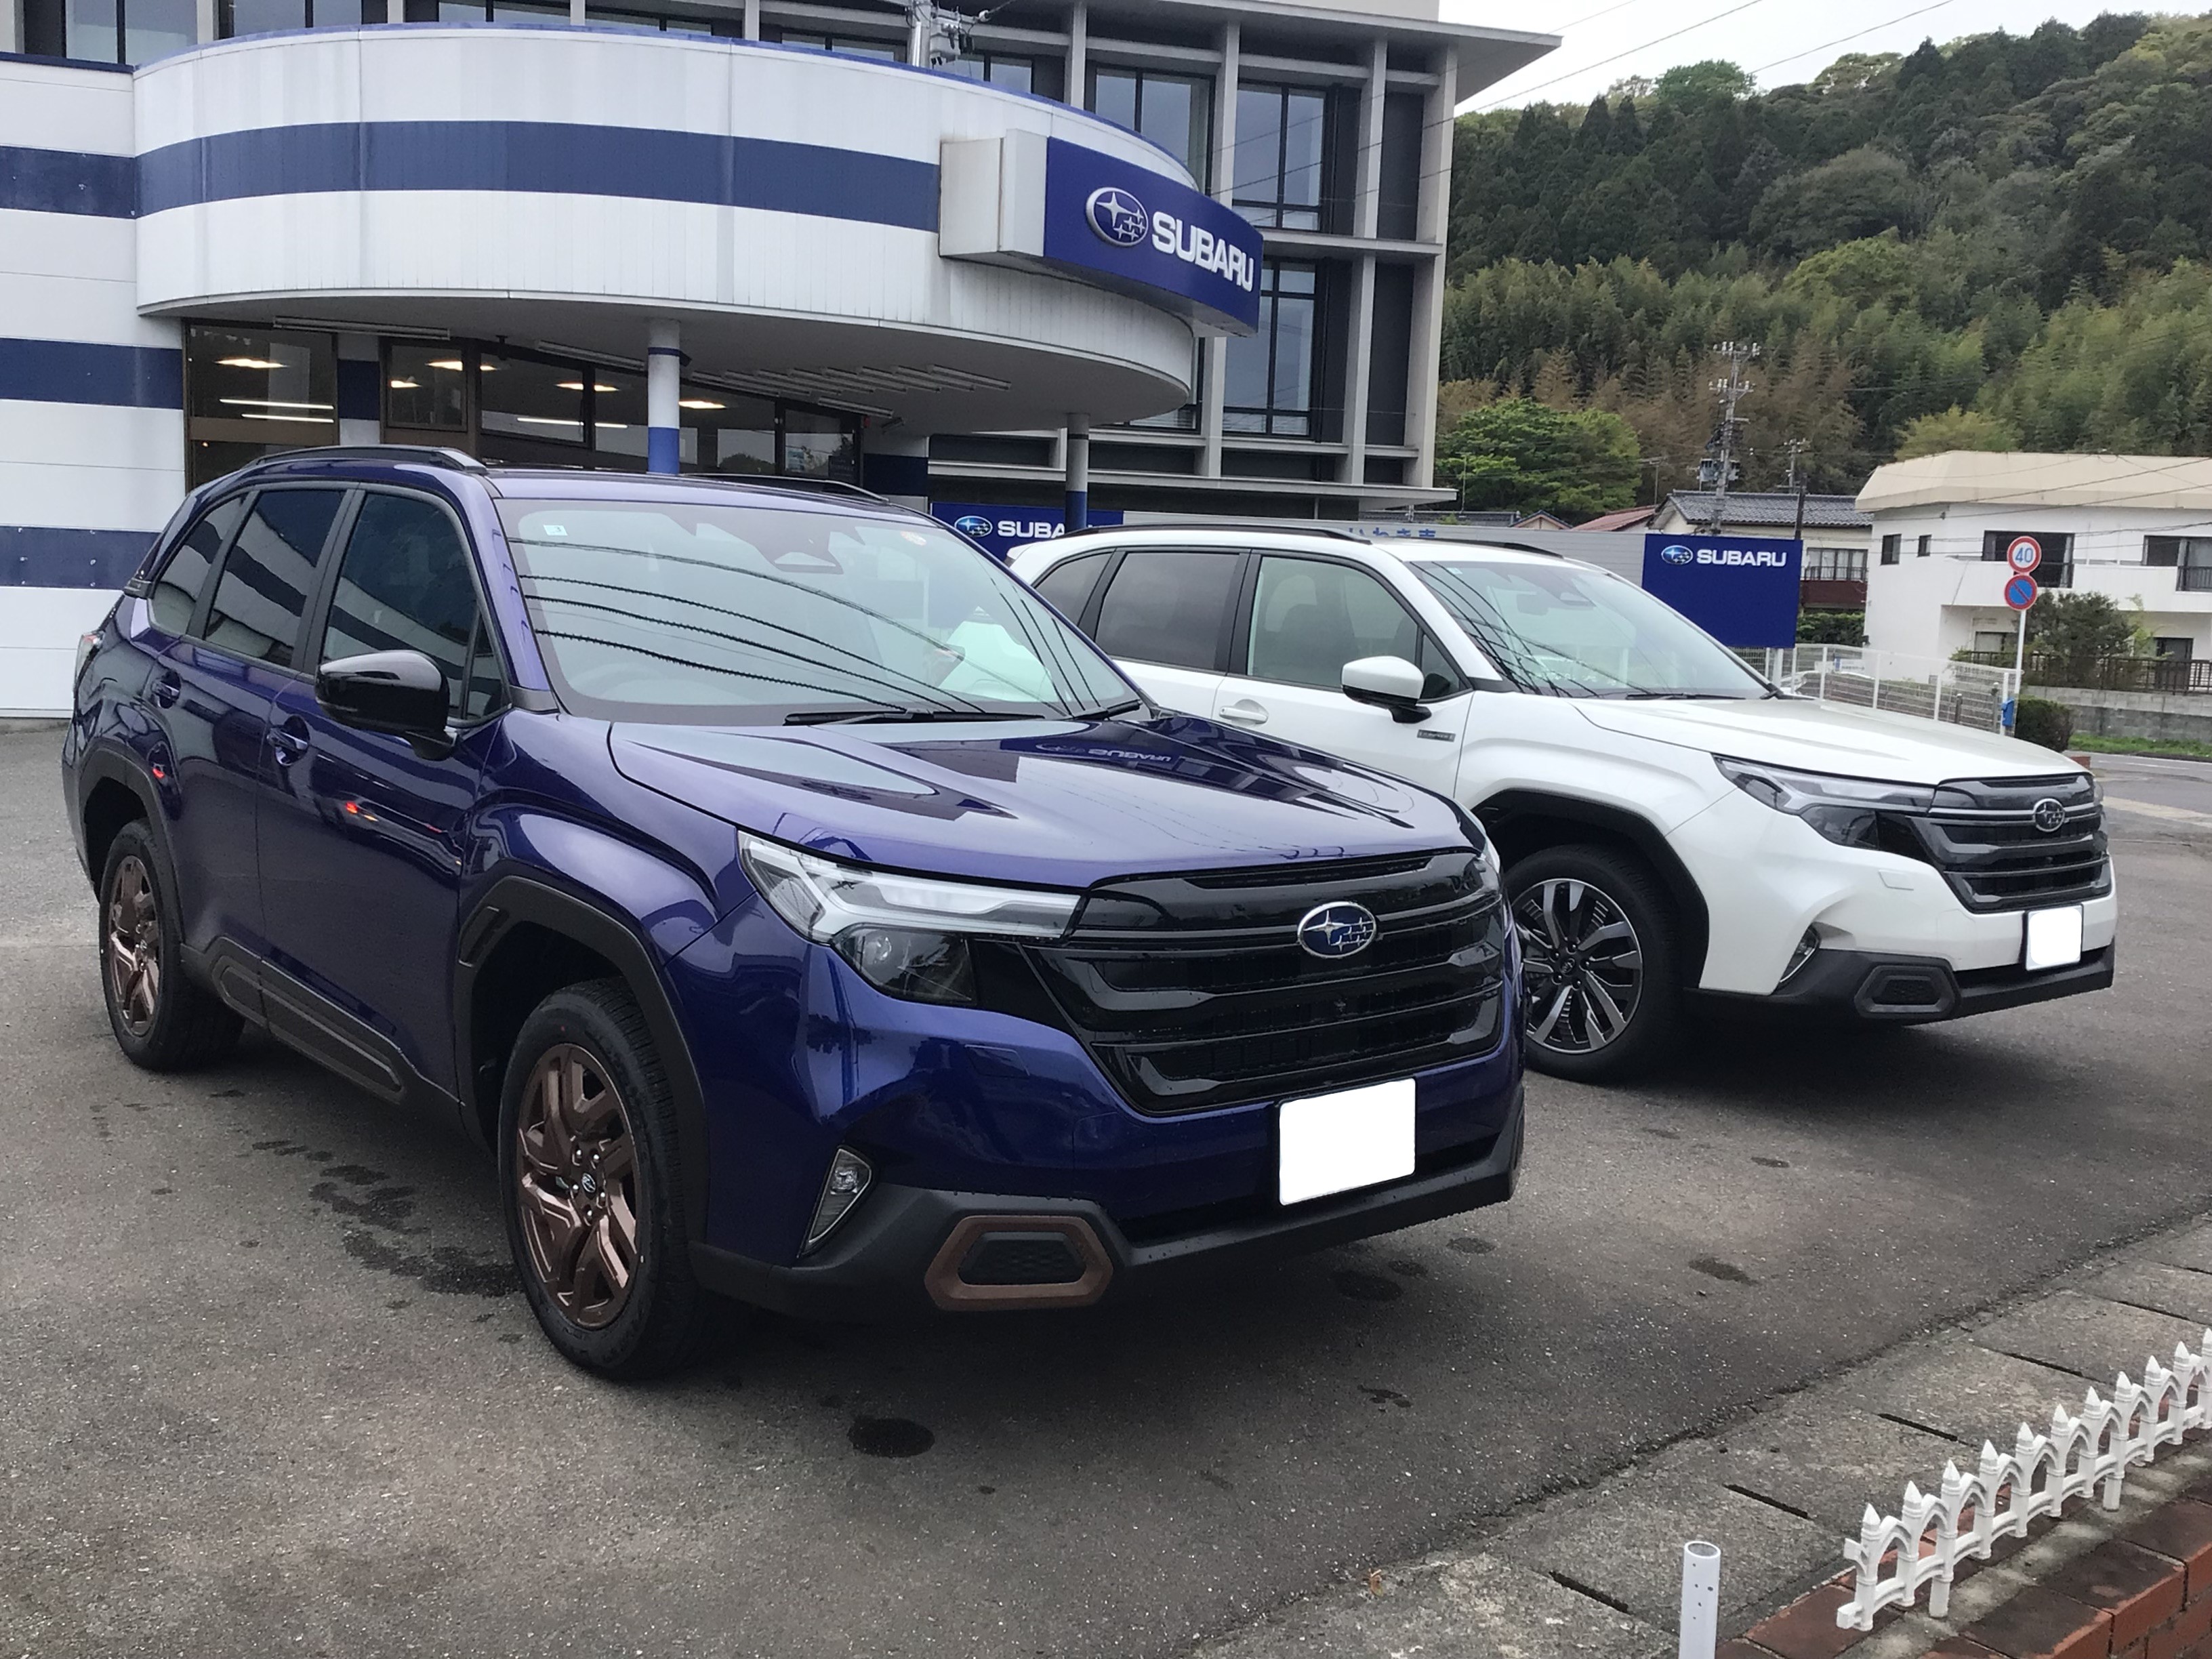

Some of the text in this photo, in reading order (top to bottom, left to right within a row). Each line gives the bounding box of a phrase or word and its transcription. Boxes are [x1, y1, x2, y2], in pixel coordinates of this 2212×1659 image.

[1152, 211, 1254, 291] SUBARU
[998, 520, 1065, 539] SUBA
[1697, 550, 1786, 567] SUBARU
[2015, 548, 2033, 562] 40
